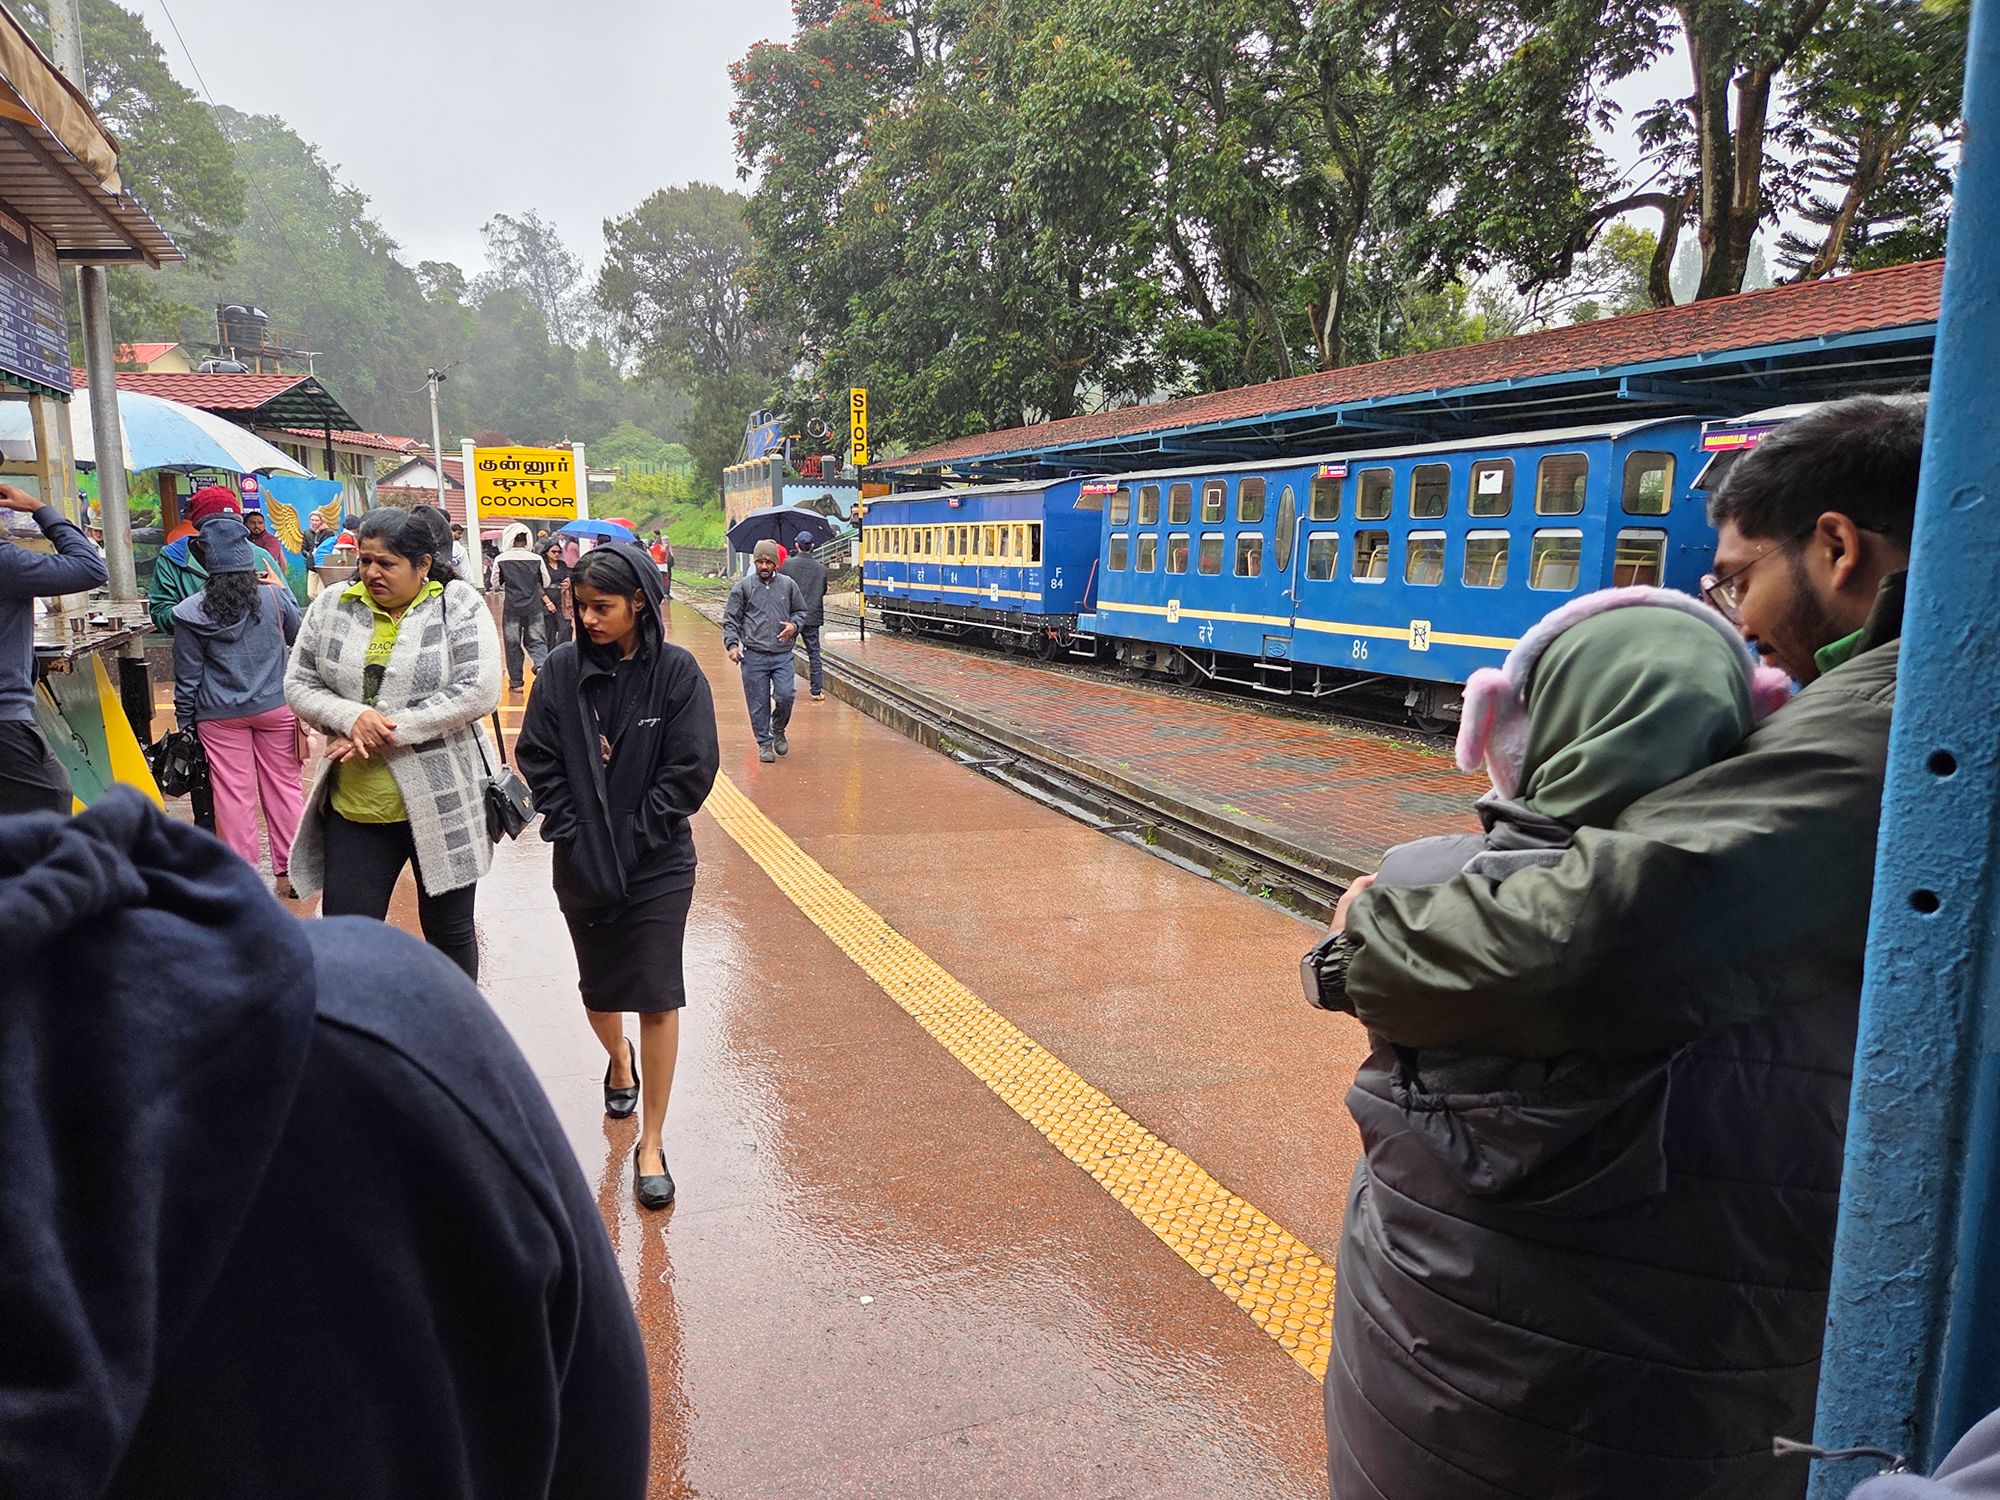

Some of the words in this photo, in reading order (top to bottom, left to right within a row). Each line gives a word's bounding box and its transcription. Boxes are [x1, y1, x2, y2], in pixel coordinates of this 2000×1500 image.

[853, 394, 865, 457] STOP
[479, 455, 569, 475] குன்னூர்
[480, 496, 574, 507] COONOOR
[950, 571, 958, 584] 84
[1055, 567, 1062, 578] F
[1050, 578, 1063, 589] 84
[1352, 639, 1368, 660] 86
